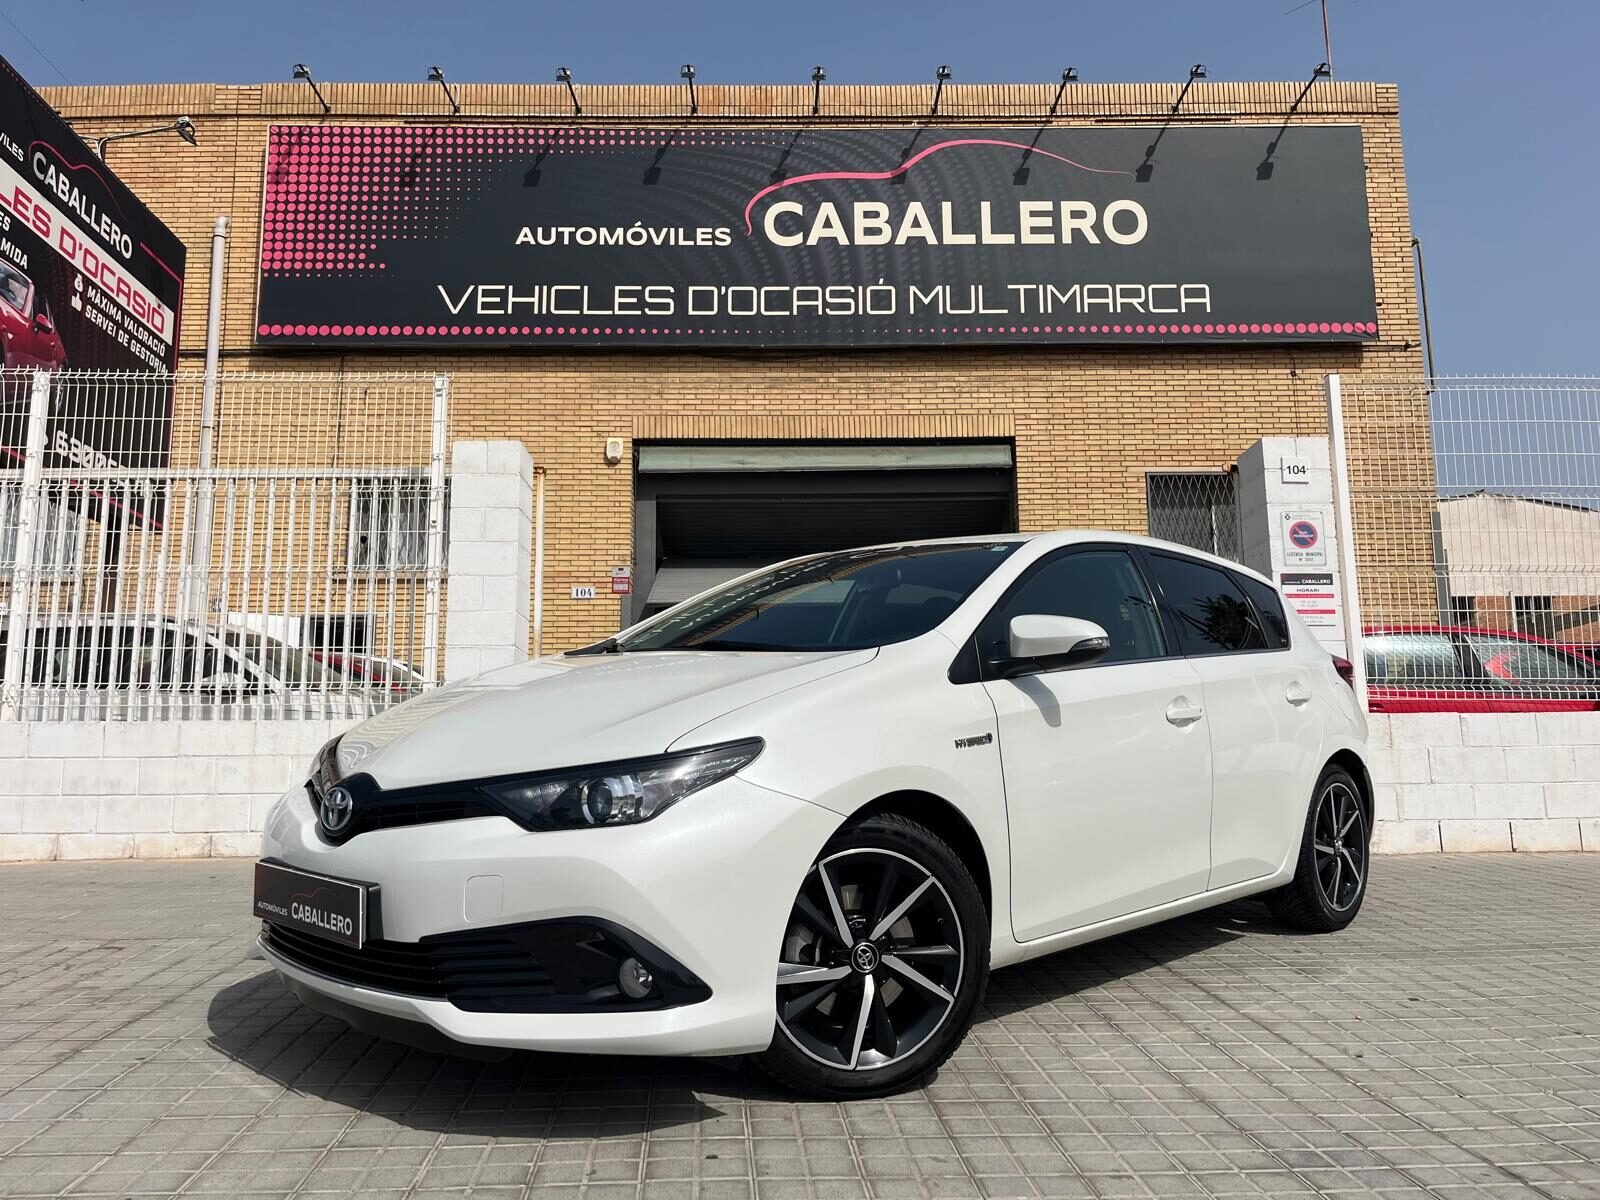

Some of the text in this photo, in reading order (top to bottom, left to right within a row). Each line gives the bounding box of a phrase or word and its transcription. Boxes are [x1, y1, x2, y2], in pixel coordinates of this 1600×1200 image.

[33, 151, 133, 260] CABALLERO
[515, 199, 1149, 247] AUTOMÓVILES CABALLERO
[0, 237, 28, 270] MIDA
[59, 226, 165, 335] D'OCASIÓ
[437, 278, 1211, 316] VEHICLES D'OCASIÓ MULTIMARCA
[85, 304, 168, 377] SERVEI DE GESTORIA
[87, 285, 166, 357] MÀXIMA VALORACIÓ
[1286, 464, 1307, 475] 104
[575, 588, 592, 598] 104
[257, 900, 353, 936] AUTOMÓVILES CABALLERO
